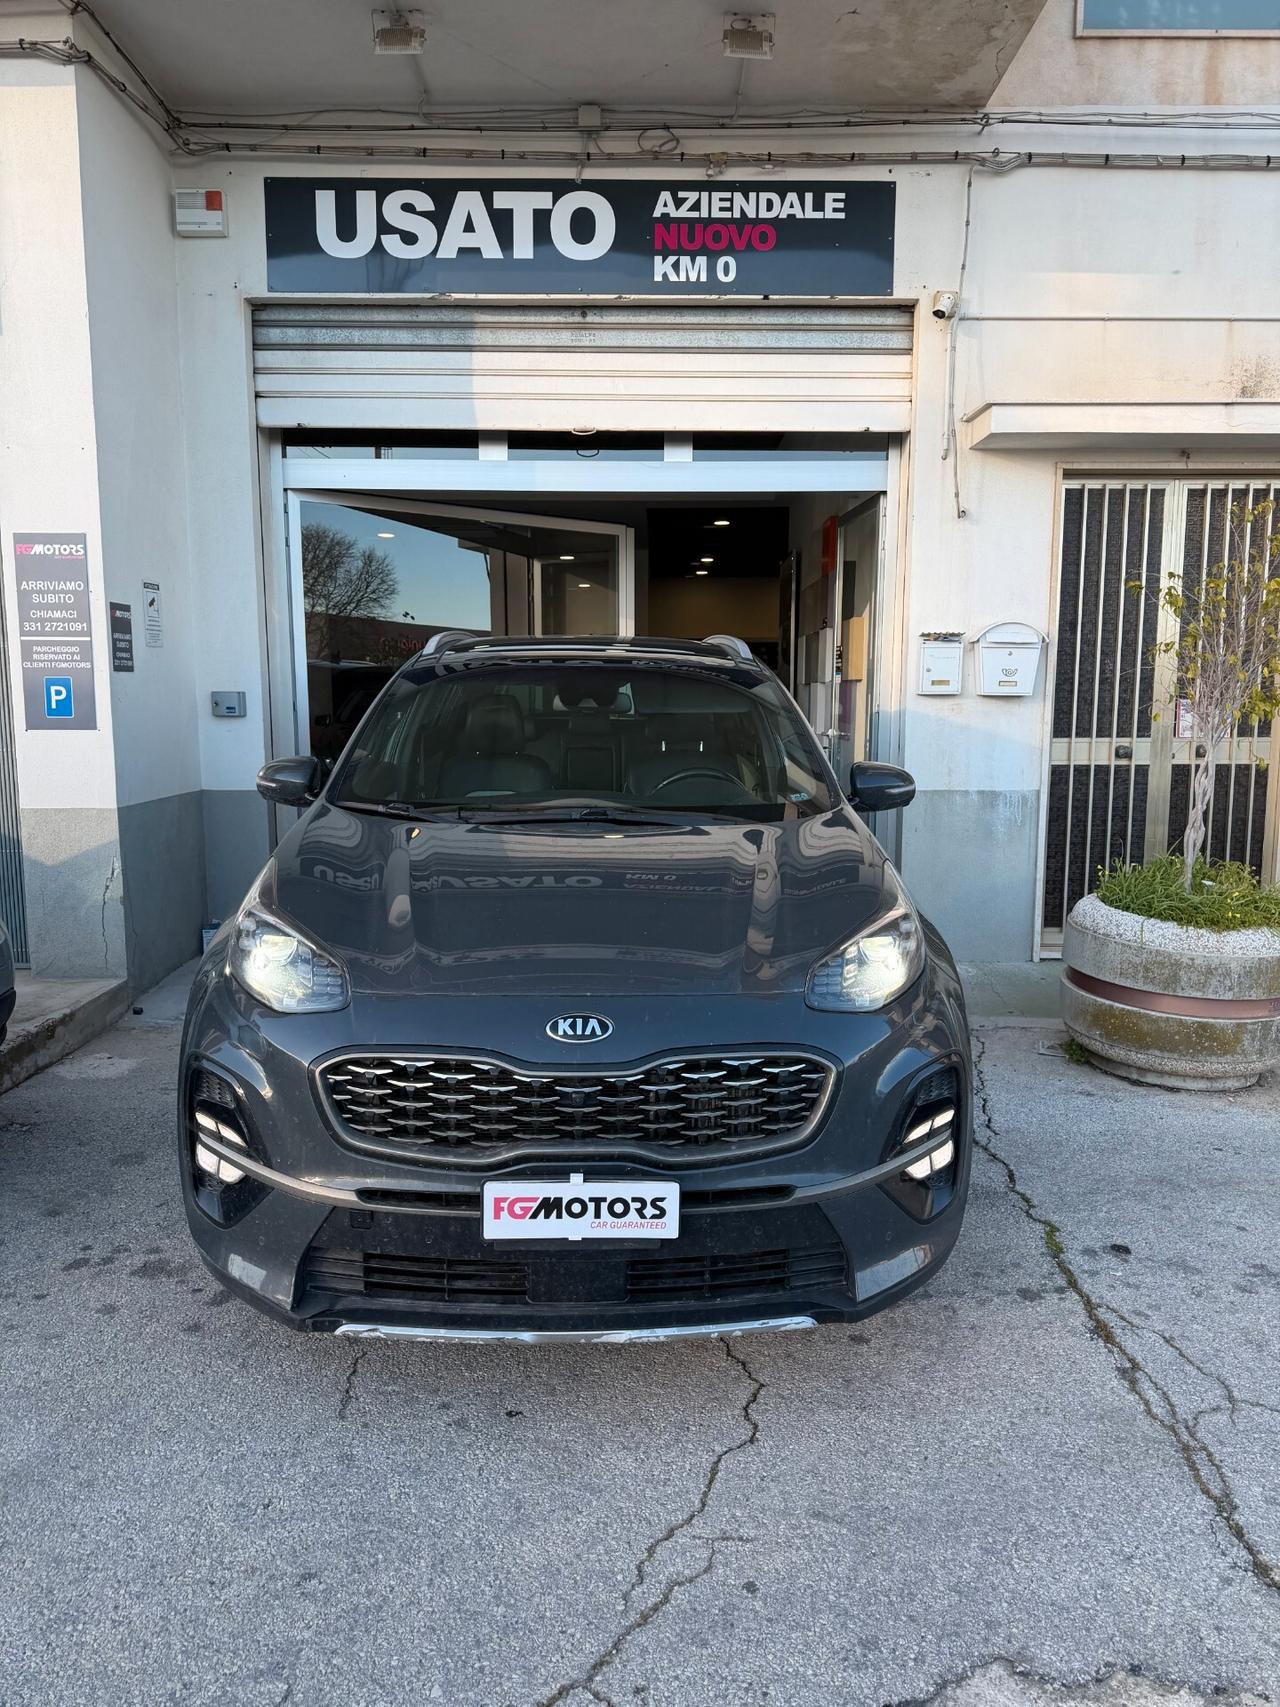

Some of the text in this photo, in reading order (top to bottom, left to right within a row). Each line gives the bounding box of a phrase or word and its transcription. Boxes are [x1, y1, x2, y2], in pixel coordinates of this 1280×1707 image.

[652, 191, 846, 219] AZIENDALE
[315, 189, 616, 261] USATO
[654, 223, 777, 251] NUOVO
[653, 255, 737, 283] KM 0
[21, 580, 84, 591] ARRIVIAMO
[32, 593, 74, 604] SUBITO
[30, 609, 77, 619] CHIAMACI
[23, 621, 87, 632] 331 2721091
[33, 645, 79, 653] PARCHEGGIO
[33, 653, 72, 661] RISERVATO
[23, 661, 92, 669] CLIENTI FGMOTORS
[50, 685, 67, 709] P
[557, 1018, 602, 1036] KIA
[493, 1196, 667, 1220] FGMOTORS
[590, 1221, 667, 1230] CAR GUARANTEED
